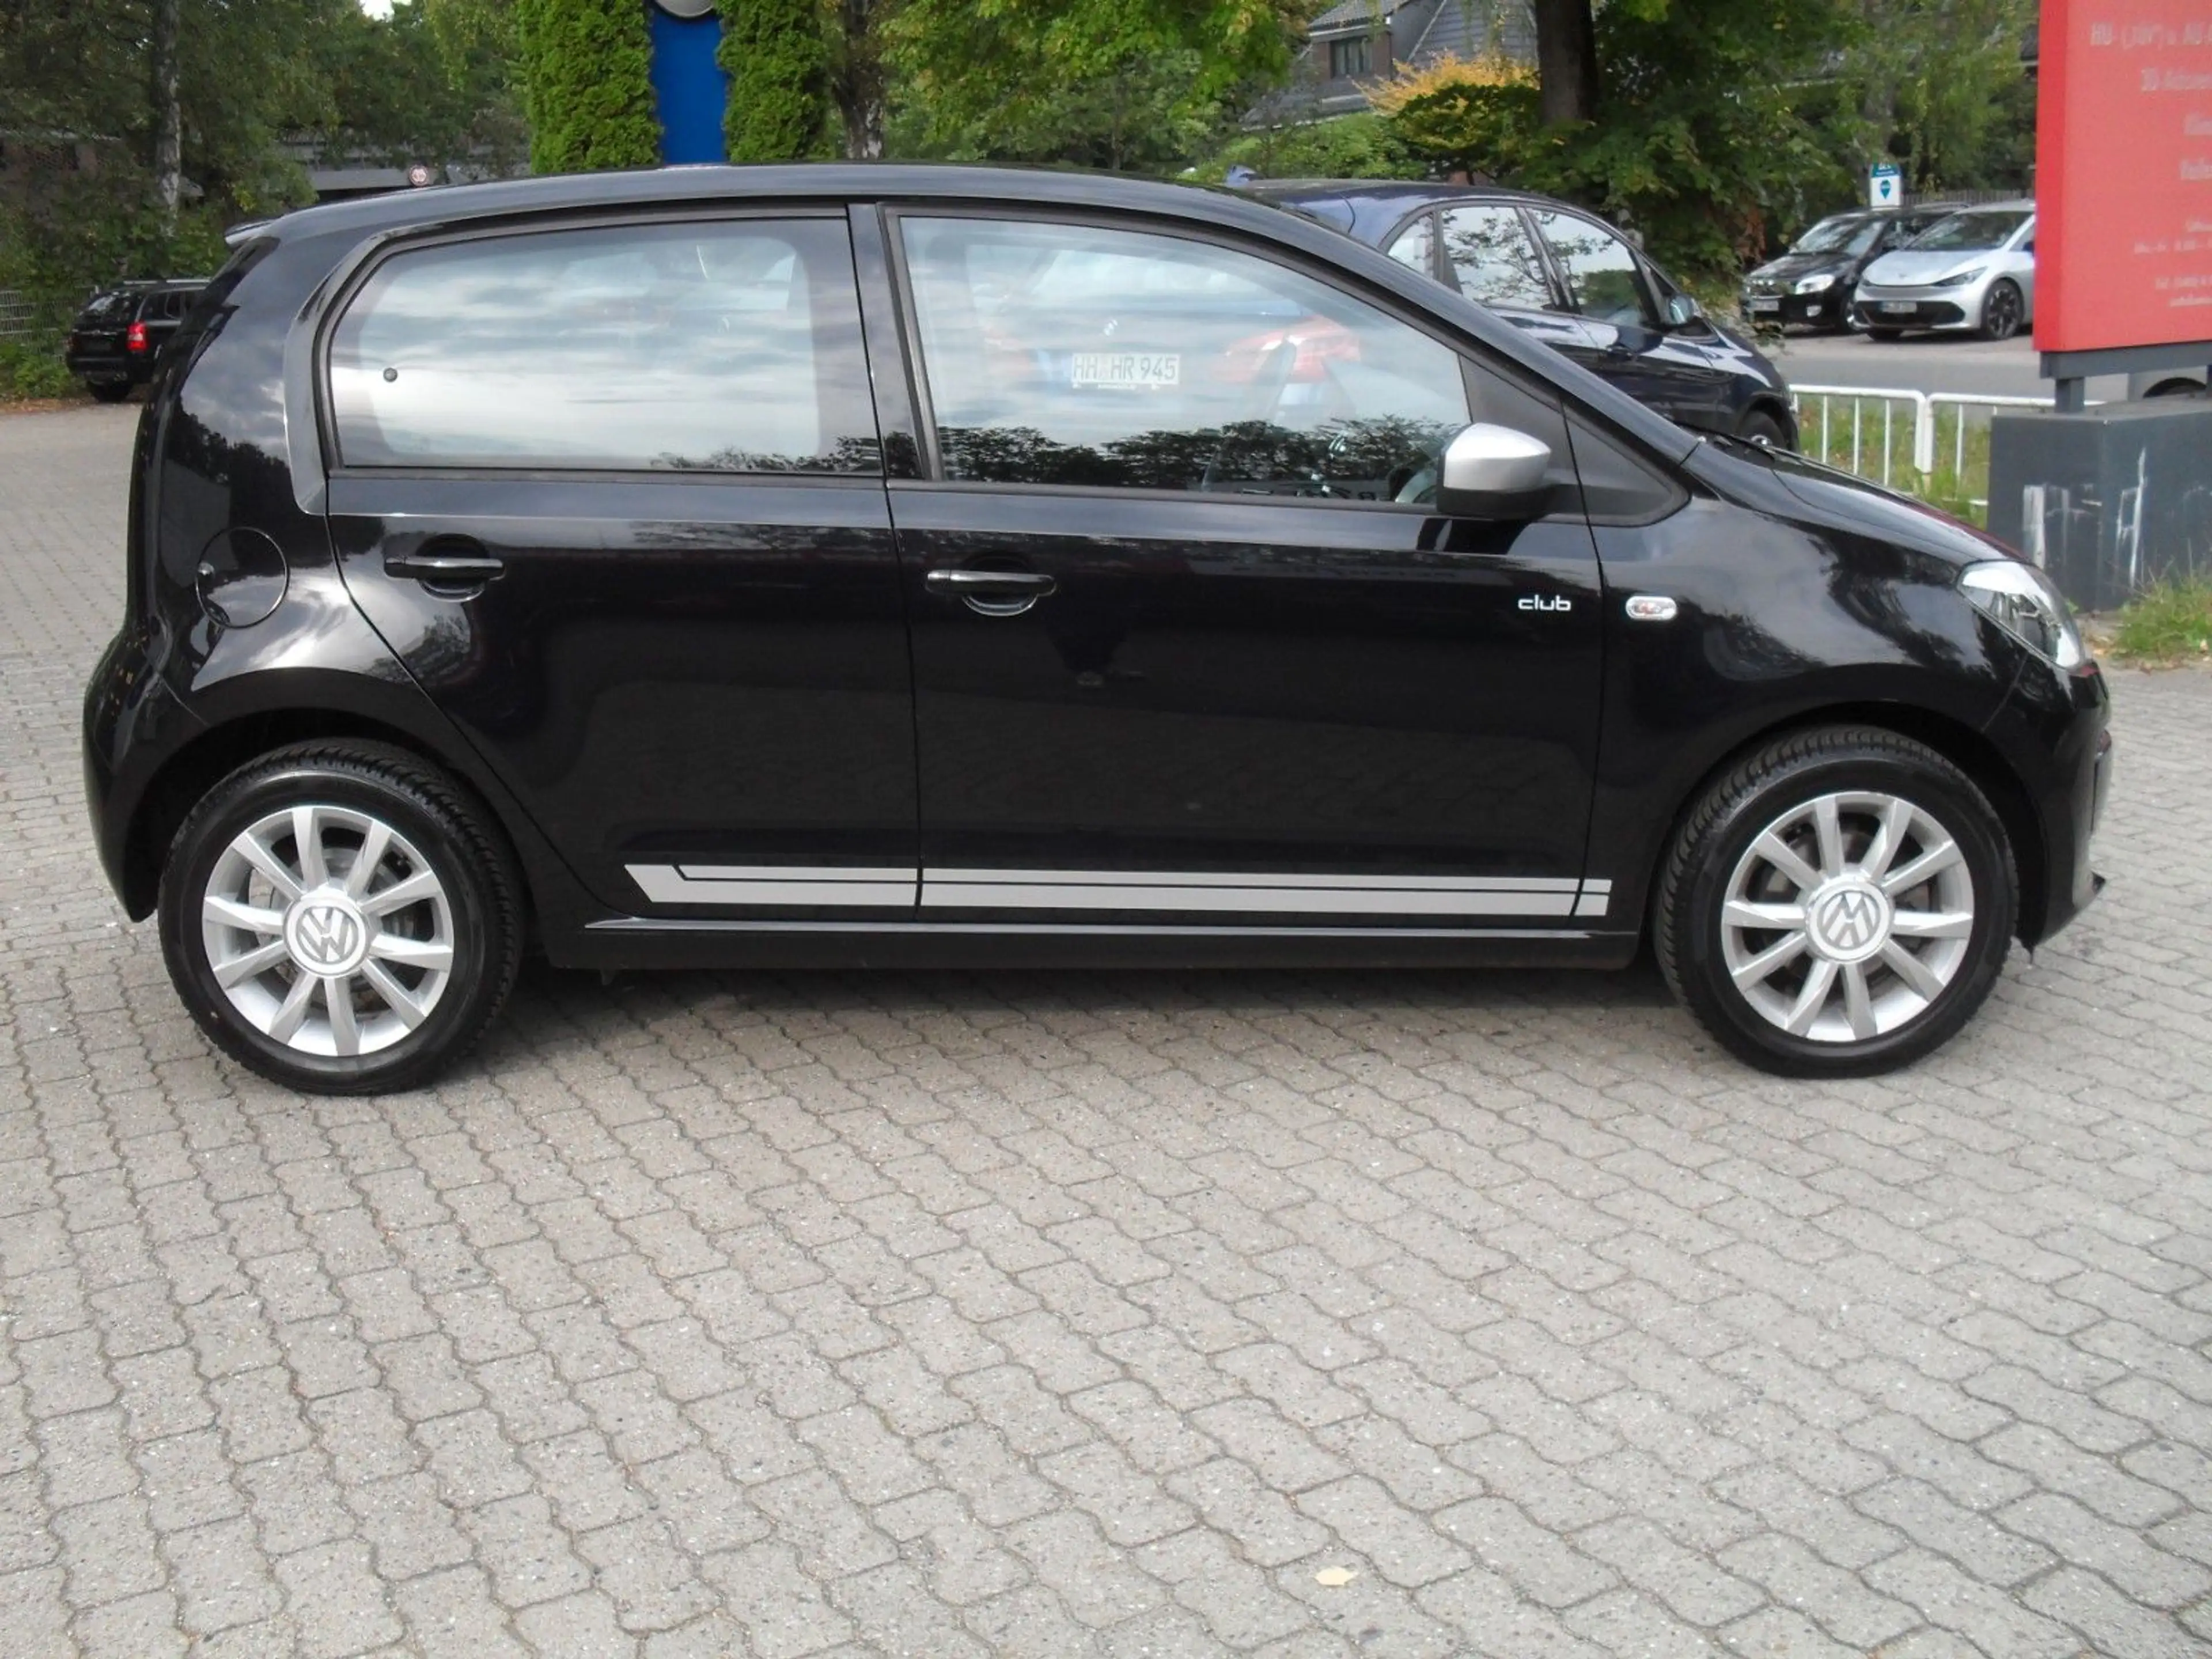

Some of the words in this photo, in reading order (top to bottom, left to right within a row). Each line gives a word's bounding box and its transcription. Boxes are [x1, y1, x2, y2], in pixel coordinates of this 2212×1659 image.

[1074, 355, 1097, 379] HH
[1111, 357, 1134, 380] HR
[1139, 357, 1177, 381] 945
[1517, 594, 1572, 612] club
